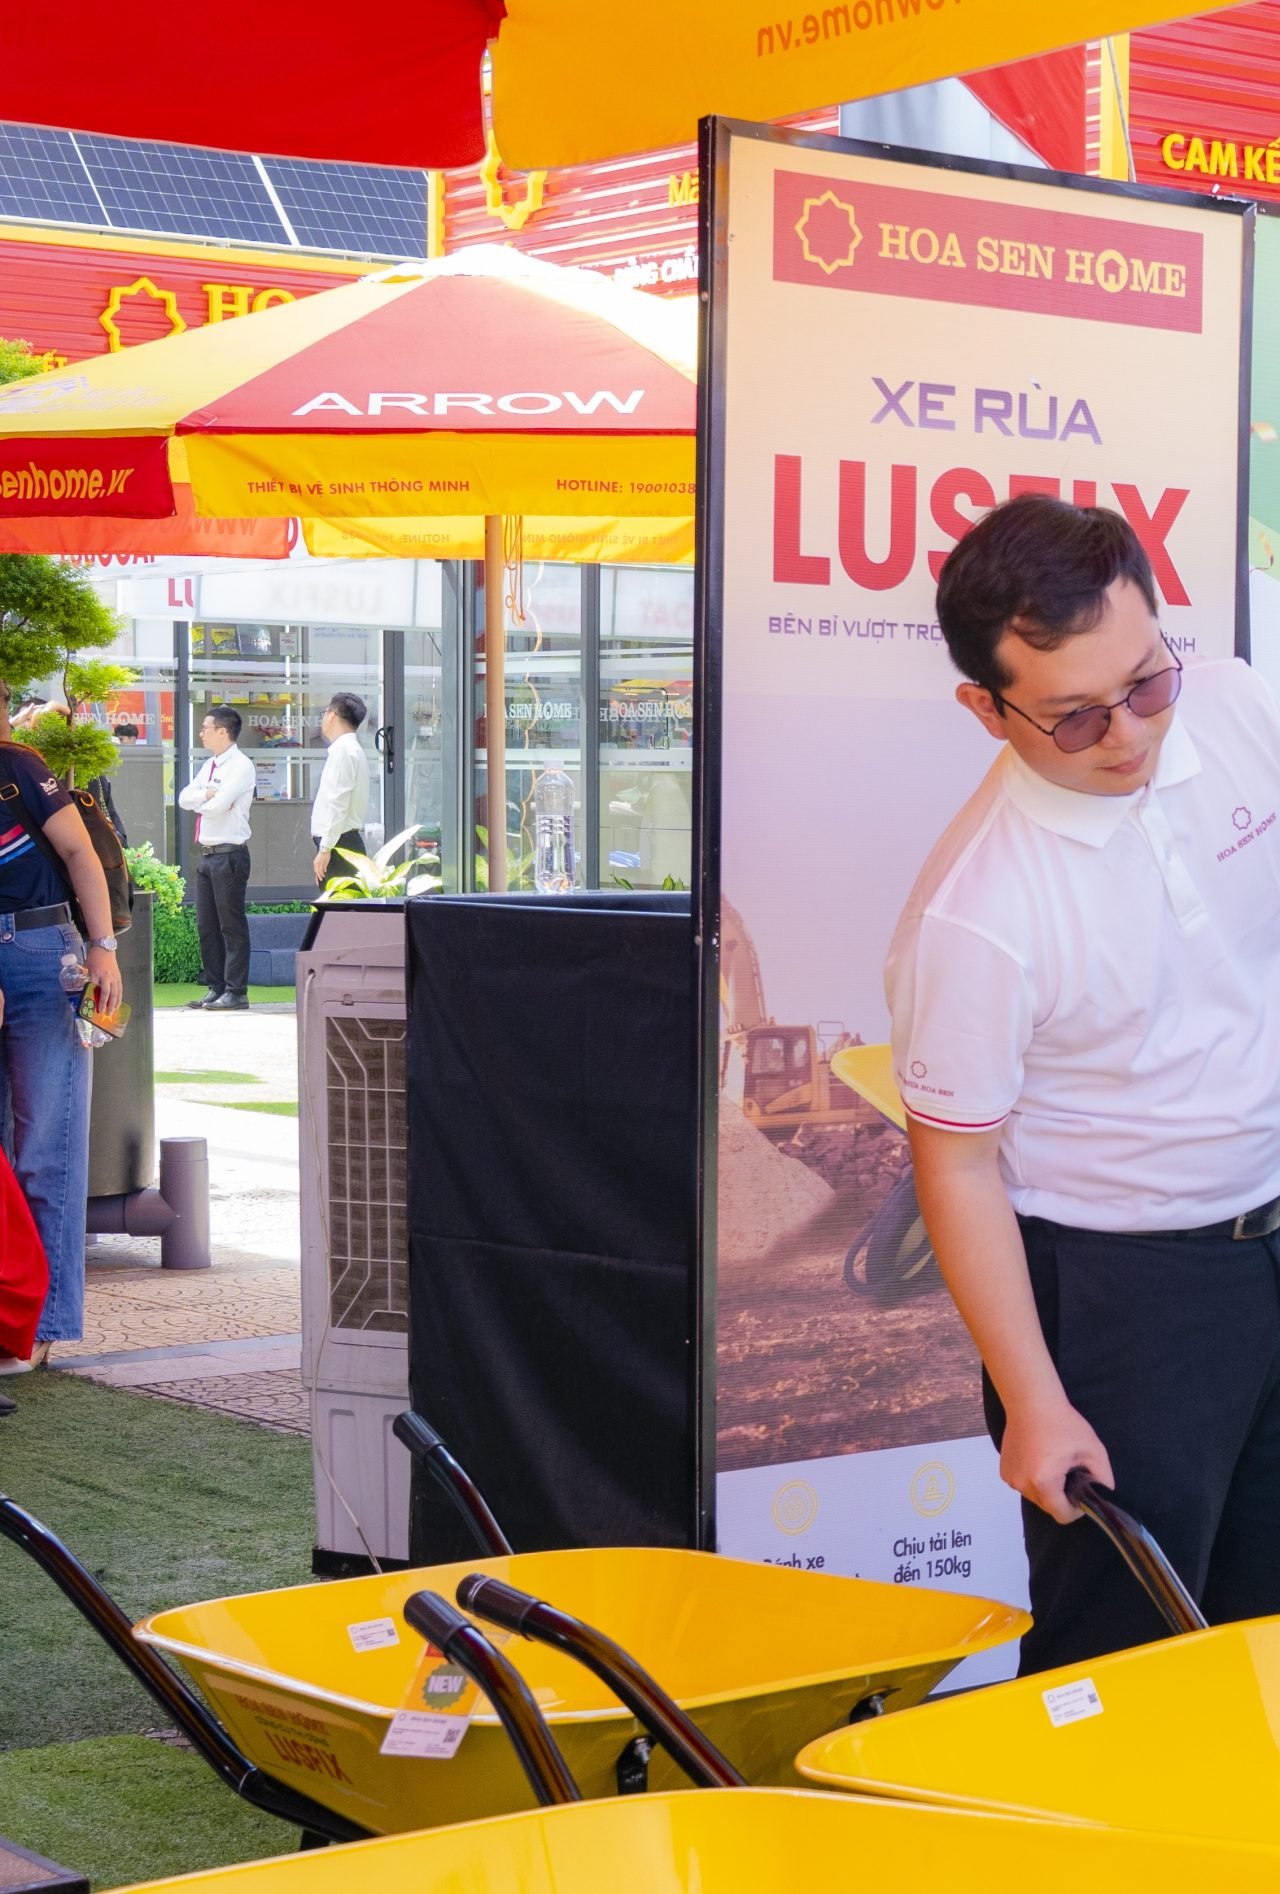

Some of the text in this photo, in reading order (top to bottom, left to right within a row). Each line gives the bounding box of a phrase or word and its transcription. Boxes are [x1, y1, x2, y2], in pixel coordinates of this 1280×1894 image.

[1162, 133, 1236, 178] CAM
[878, 222, 1186, 297] HOA SEN HOME
[291, 390, 644, 416] ARROW
[870, 376, 1102, 444] XE RÙA
[247, 476, 470, 497] THIẾT BỊ VỆ SINH THÔNG MINH
[557, 479, 622, 493] HOTLINE:
[773, 454, 1192, 606] LUSX
[843, 619, 898, 644] VƯỢT
[903, 620, 944, 647] TRỘ
[893, 1529, 972, 1559] Chịu tải lên
[806, 1555, 825, 1570] xe
[894, 1555, 971, 1583] đến 150kg
[428, 1675, 464, 1693] NEW
